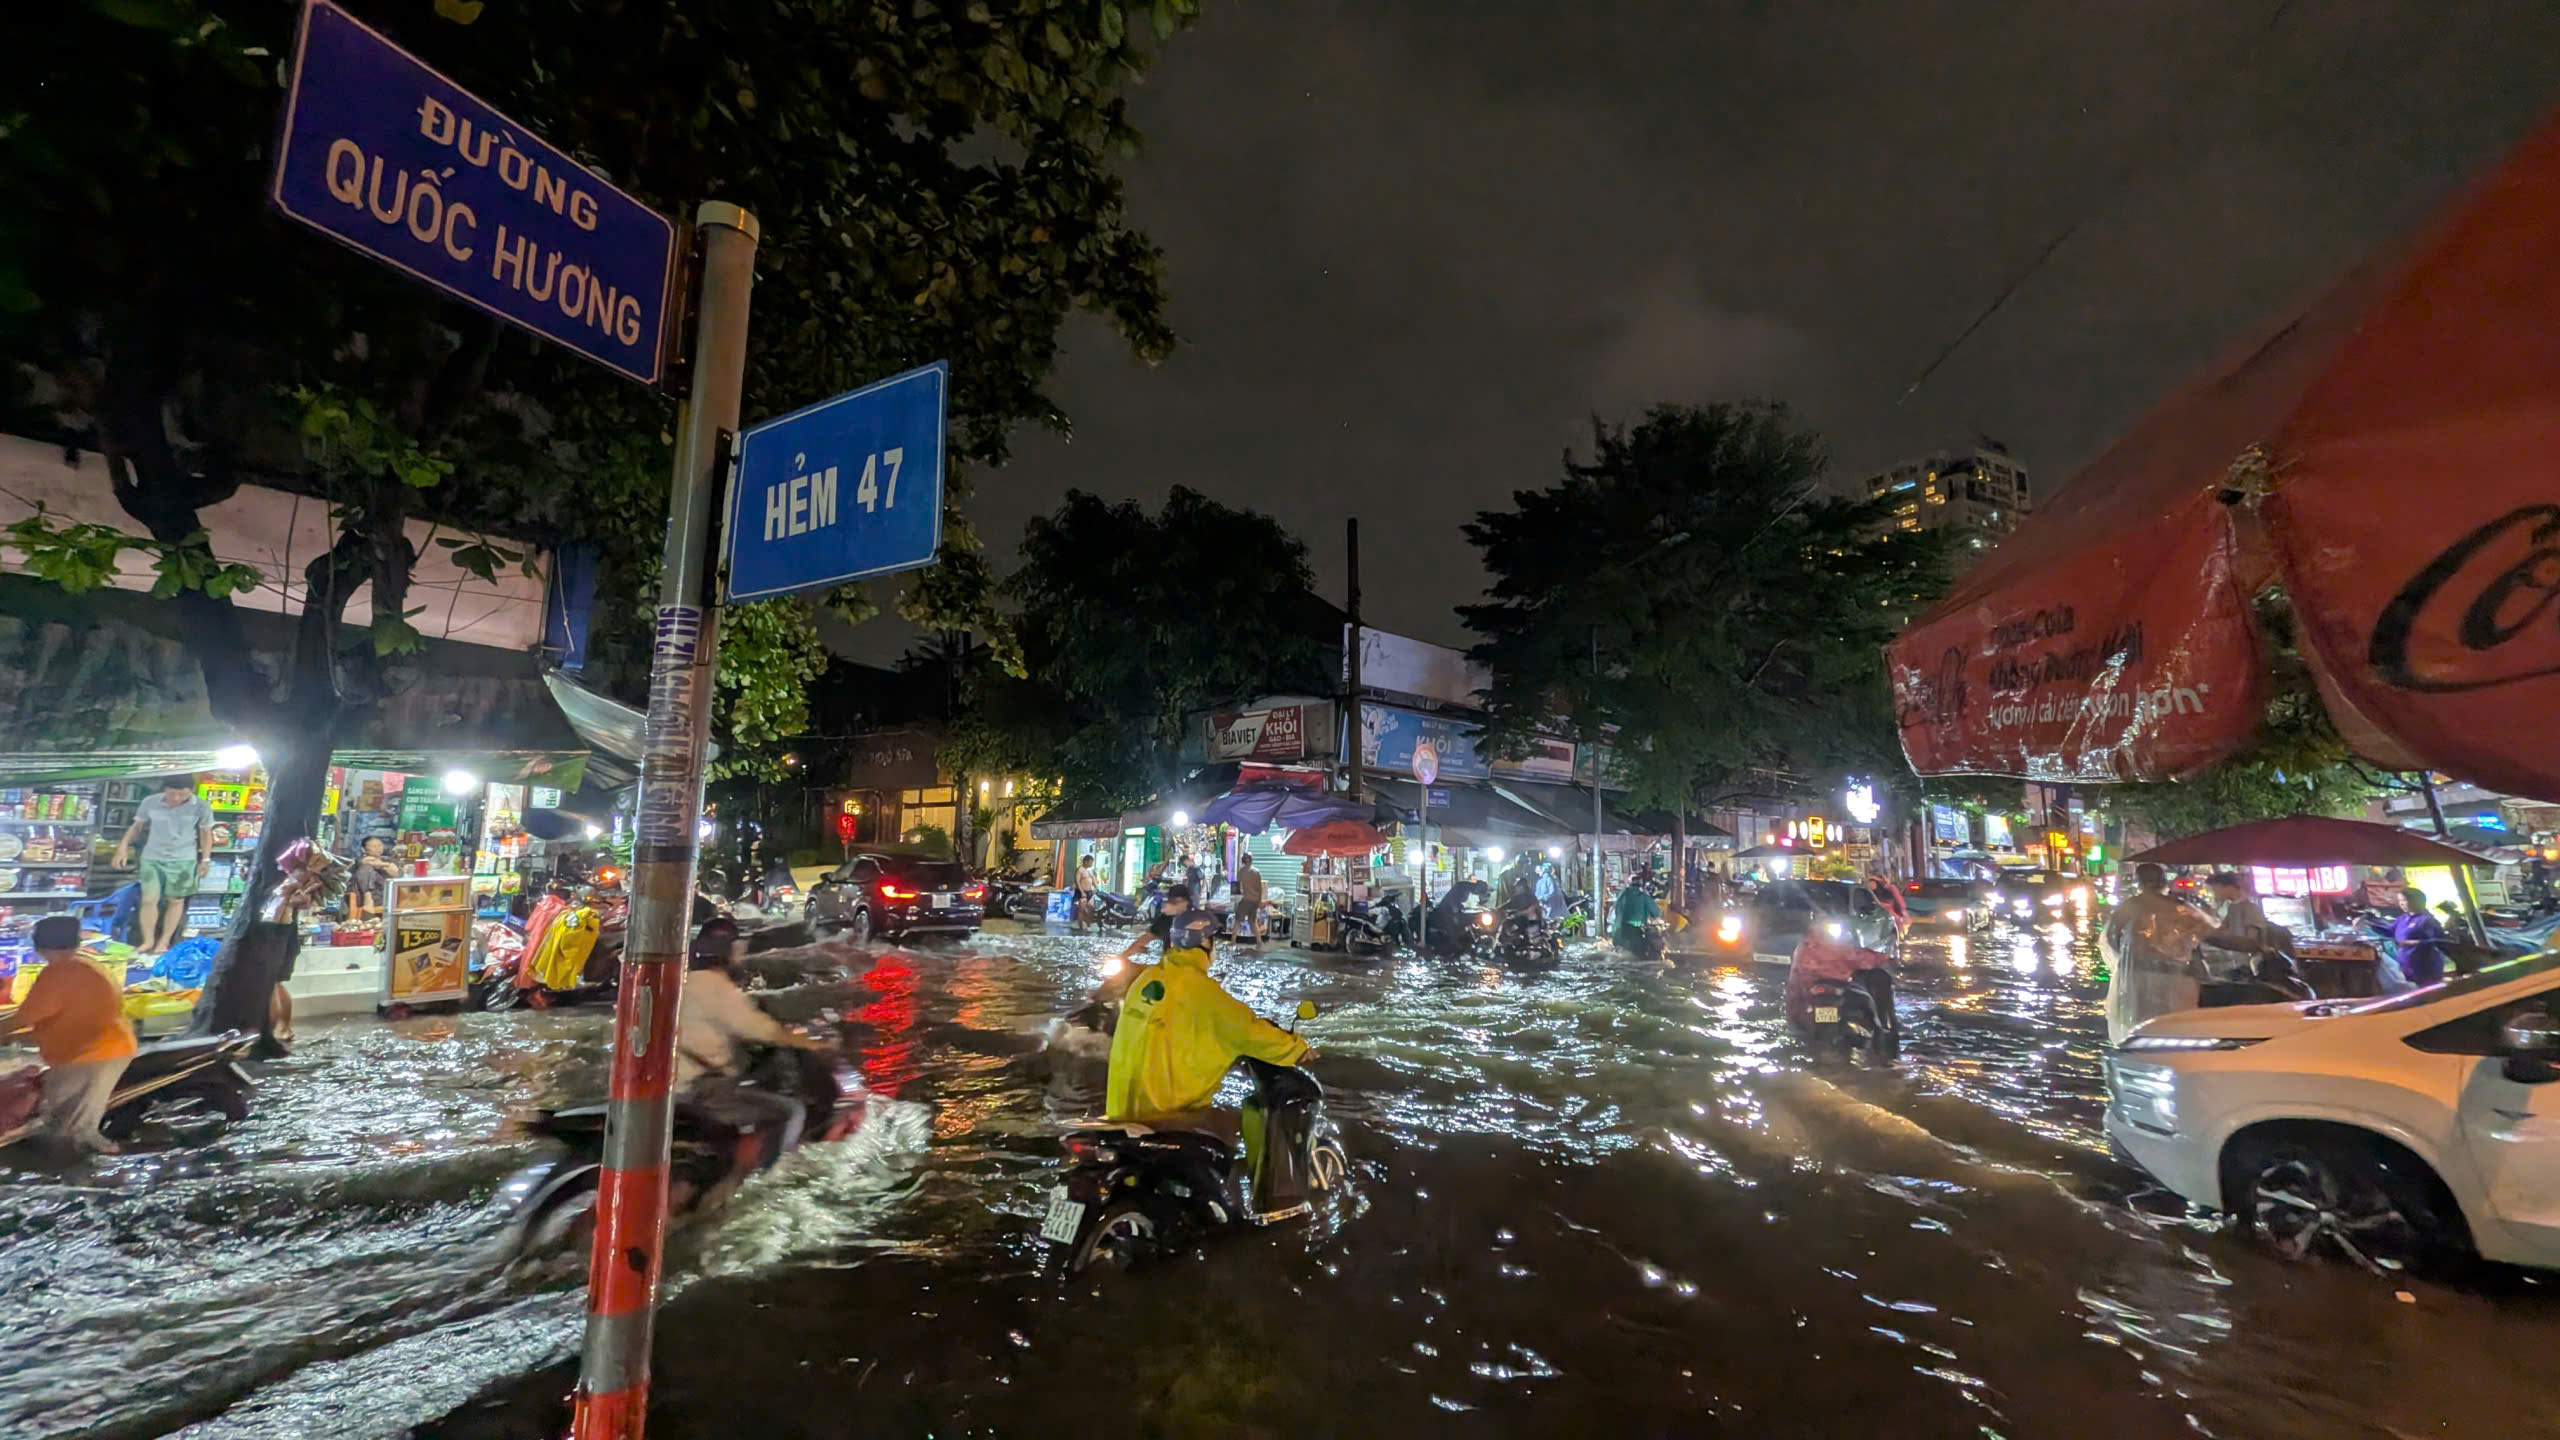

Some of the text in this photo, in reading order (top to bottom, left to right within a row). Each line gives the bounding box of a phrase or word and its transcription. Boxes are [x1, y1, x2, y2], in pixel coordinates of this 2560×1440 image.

[416, 96, 599, 231] ĐƯỜNG
[326, 138, 642, 347] QUỐC HƯƠNG
[764, 447, 904, 541] HẺM 47
